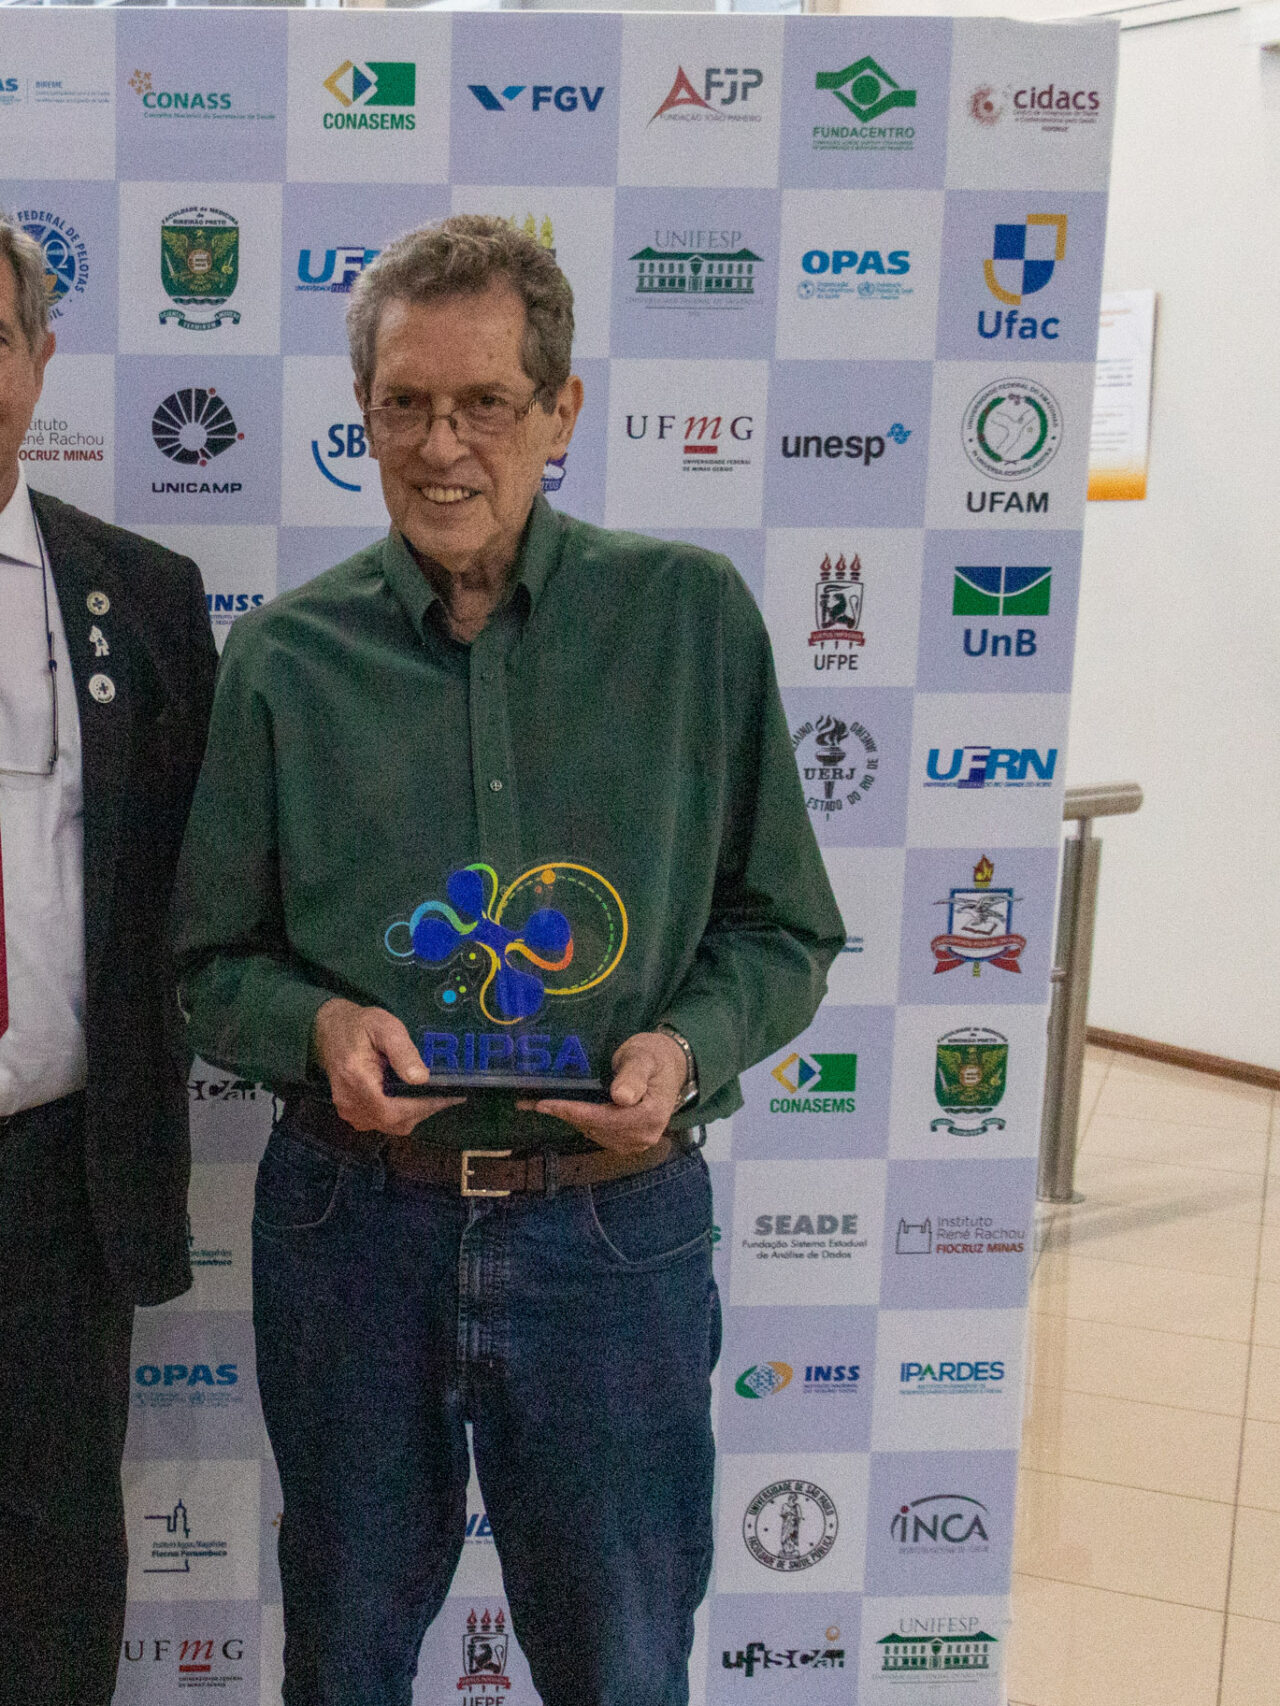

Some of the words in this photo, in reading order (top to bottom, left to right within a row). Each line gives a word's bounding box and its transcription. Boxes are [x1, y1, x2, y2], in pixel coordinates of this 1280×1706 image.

[704, 67, 763, 105] FJP
[142, 92, 231, 109] CONASS
[531, 85, 606, 112] FGV
[1014, 84, 1099, 110] cidacs
[323, 113, 416, 130] CONASEMS
[813, 127, 915, 139] FUNDACENTRO
[655, 231, 742, 248] UNIFESP
[17, 210, 66, 230] FEDERAL
[65, 227, 80, 243] DE
[75, 242, 89, 294] PELOTAS
[802, 250, 911, 274] OPAS
[978, 311, 1060, 339] Ufac
[29, 418, 68, 431] tituto
[24, 433, 45, 445] ené
[49, 432, 104, 446] Rachou
[19, 449, 60, 461] OCRUZ
[63, 450, 104, 461] MINAS
[781, 435, 885, 466] unesp
[152, 482, 242, 494] UNICAMP
[967, 491, 1048, 513] UFAM
[964, 628, 1037, 657] UnB
[814, 654, 859, 670] UFPE
[927, 747, 1058, 780] UFRN
[803, 768, 855, 780] UERJ
[423, 1030, 592, 1076] RIPSA
[770, 1099, 856, 1113] CONASEMS
[754, 1215, 857, 1235] SEADE
[938, 1217, 992, 1227] Instituto
[937, 1228, 970, 1239] René
[974, 1228, 1024, 1239] Rachou
[742, 1240, 787, 1250] Fundação
[828, 1239, 867, 1247] Estadual
[937, 1244, 983, 1253] FIOCRUZ
[986, 1243, 1024, 1252] MINAS
[757, 1251, 768, 1259] de
[821, 1250, 851, 1258] Dados
[135, 1364, 238, 1386] OPAS
[805, 1366, 860, 1381] INSS
[900, 1362, 1005, 1382] IPARDES
[748, 1482, 791, 1516] UNIVERSIDADE
[819, 1494, 834, 1516] PAULO
[748, 1536, 779, 1565] FACULDADE
[811, 1535, 834, 1563] PÚBLICA
[899, 1617, 979, 1633] UNIFESP
